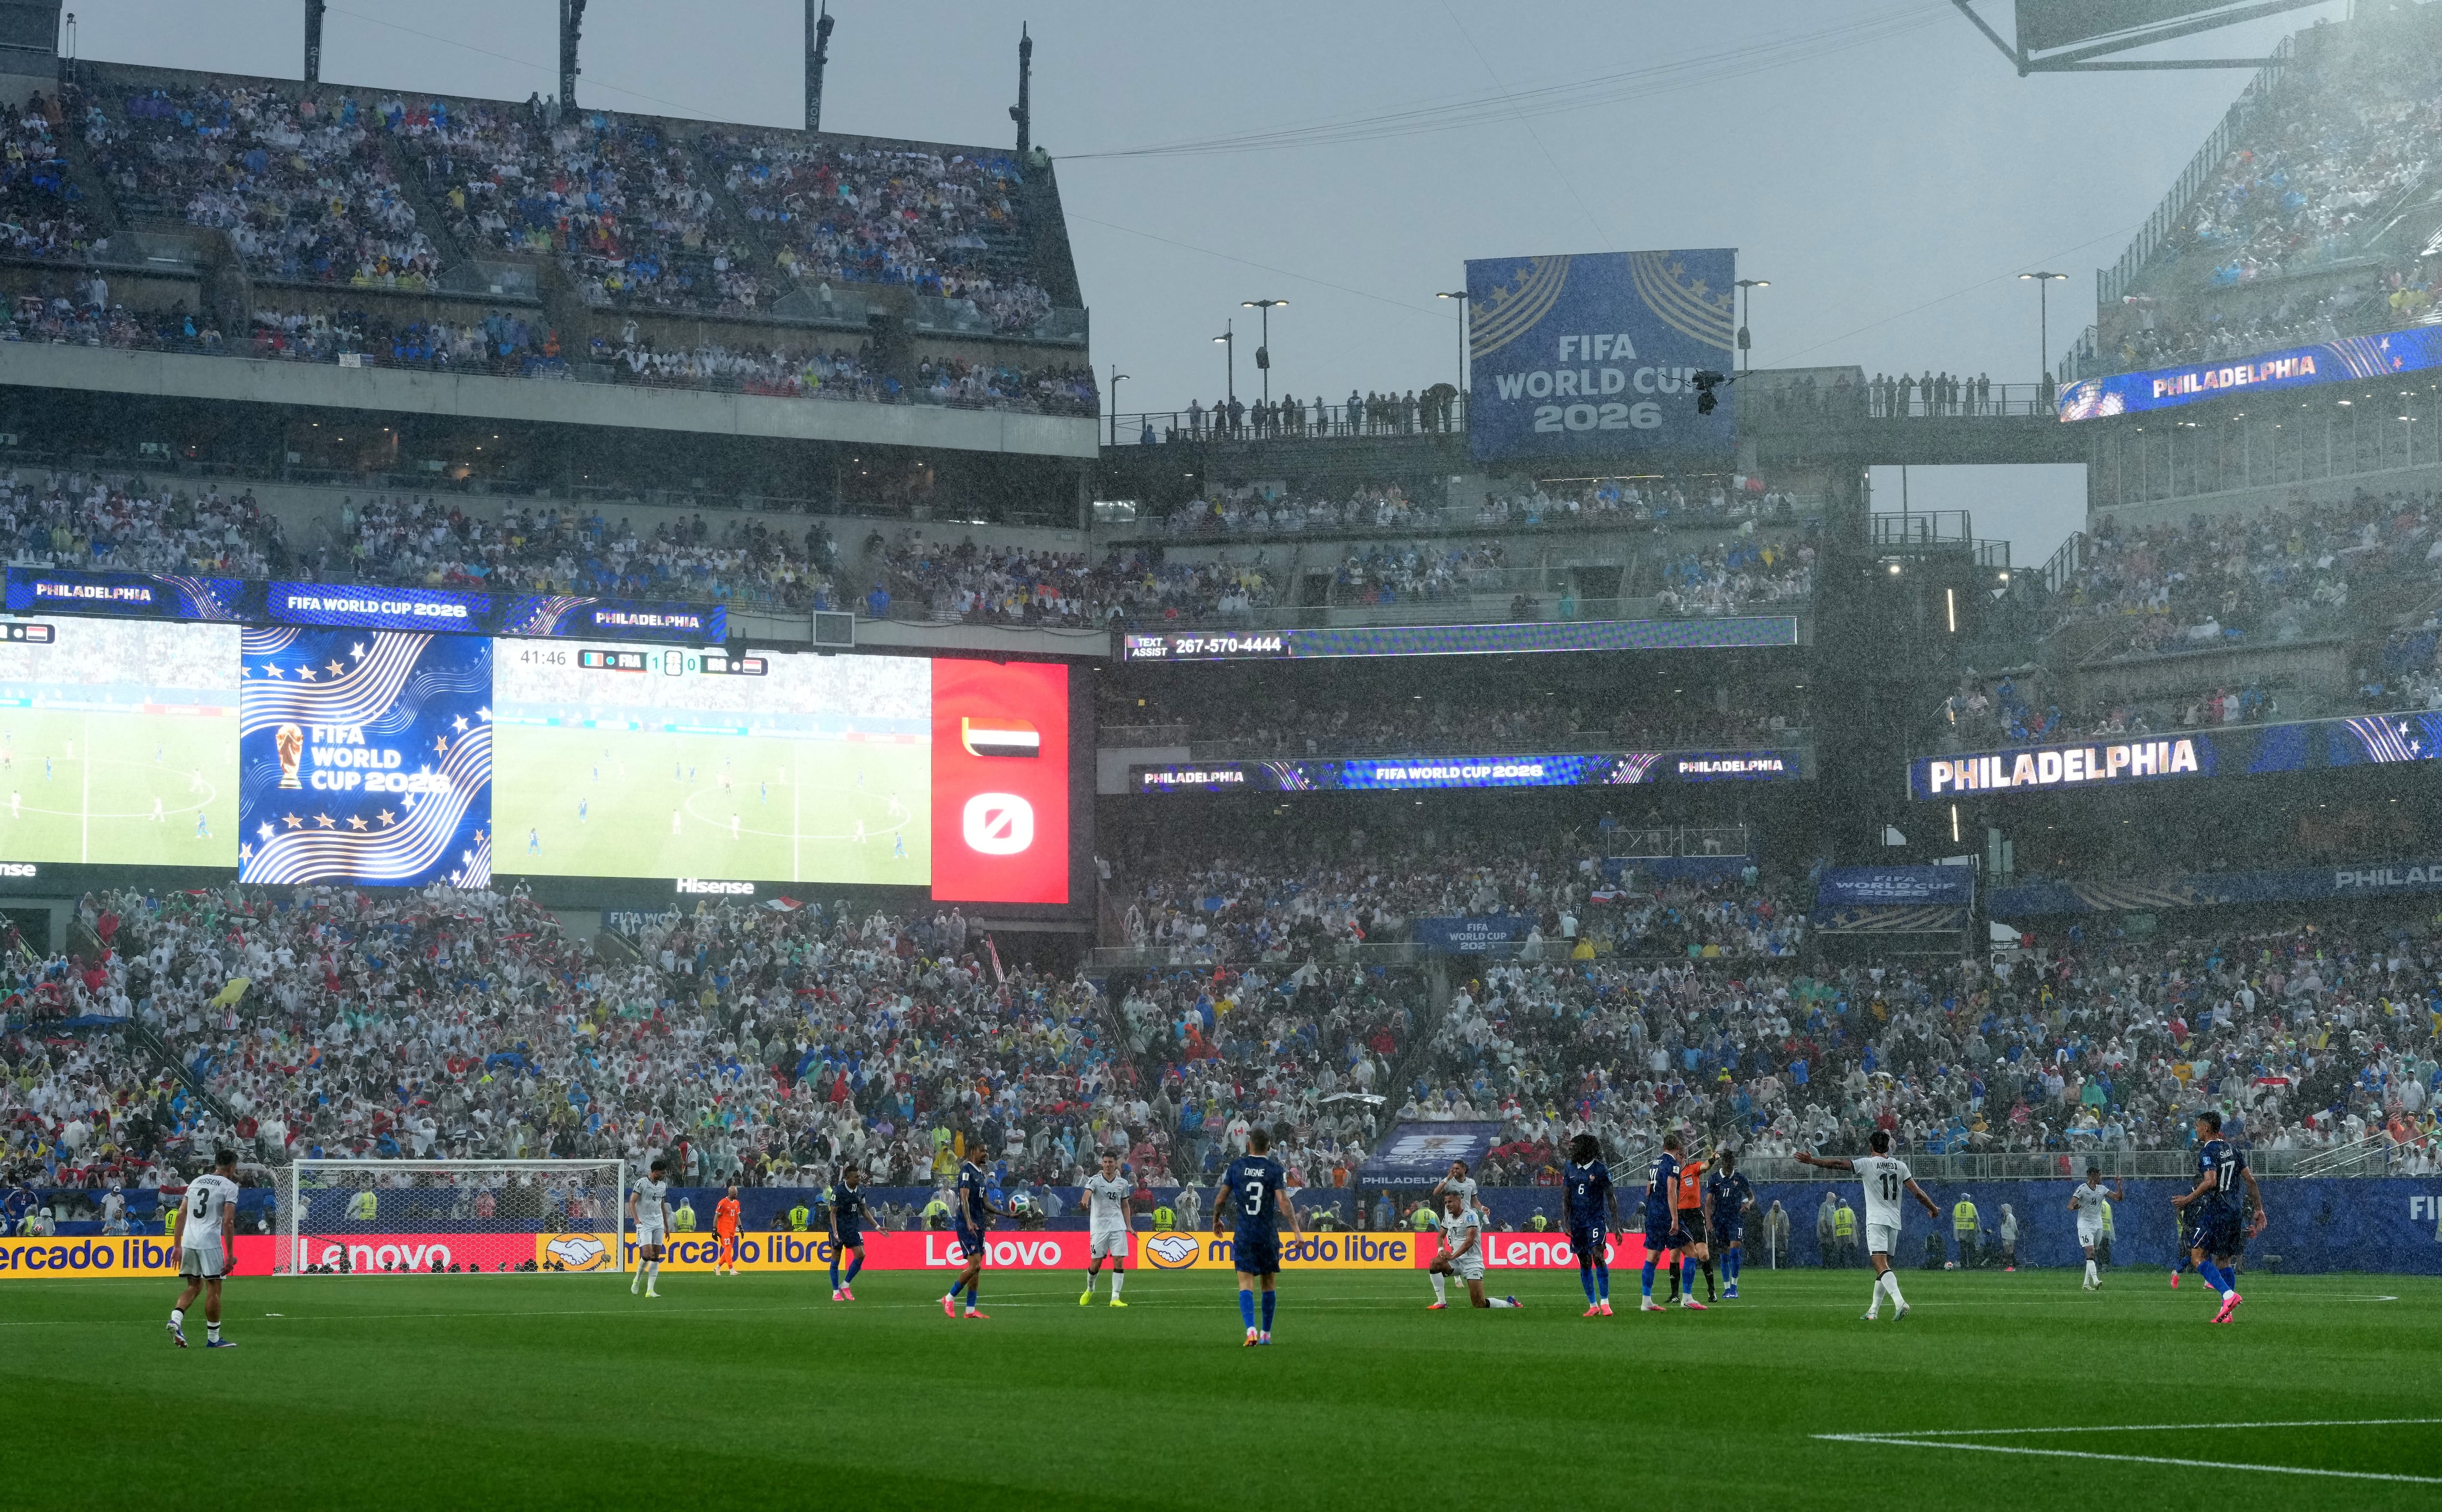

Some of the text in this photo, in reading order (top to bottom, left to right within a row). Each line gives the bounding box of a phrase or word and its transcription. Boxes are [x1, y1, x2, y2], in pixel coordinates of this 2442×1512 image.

[1559, 334, 1637, 361] FIFA
[1495, 368, 1625, 400] WORLD
[2153, 356, 2316, 398] PHILADELPHIA
[1534, 402, 1662, 433] 2026
[37, 584, 151, 601] PHILADELPHIA
[288, 596, 467, 618] FIFA WORLD CUP 2026
[596, 612, 699, 629] PHILADELPHIA
[1138, 637, 1163, 647] TEXT
[1176, 637, 1282, 653] 267-570-4444
[520, 650, 566, 665] 41:46
[1132, 647, 1167, 657] ASSIST
[619, 654, 726, 672] FRA 1 0 IRQ
[312, 724, 364, 746] FIFA
[312, 747, 401, 769] WORLD
[1679, 759, 1783, 773] PHILADELPHIA
[1931, 739, 2198, 793] PHILADELPHIA
[1145, 771, 1244, 784] PHILADELPHIA
[1376, 765, 1543, 780] FIFA WORLD CUP 2026
[312, 771, 450, 794] CUP 2026
[677, 878, 755, 894] Hisense
[610, 912, 643, 924] FIA
[1467, 923, 1488, 931] FIFA
[1244, 1168, 1265, 1177] DIGNE
[2219, 1160, 2235, 1192] 17
[979, 1186, 985, 1198] 12
[1460, 1190, 1464, 1199] 5
[1578, 1184, 1584, 1195] 6
[1723, 1188, 1729, 1197] 11
[1879, 1173, 1898, 1200] 11
[193, 1188, 210, 1218] 3
[652, 1193, 656, 1201] 4
[1245, 1181, 1262, 1216] 3
[851, 1203, 857, 1213] 10
[1453, 1226, 1457, 1236] 9
[1592, 1228, 1599, 1239] 6
[1738, 1227, 1743, 1237] 11
[2082, 1235, 2089, 1243] 16
[123, 1239, 175, 1269] libr
[300, 1238, 450, 1274] Lenovo
[768, 1235, 831, 1263] libre
[926, 1235, 1062, 1266] Lenovo
[1345, 1235, 1407, 1261] libre
